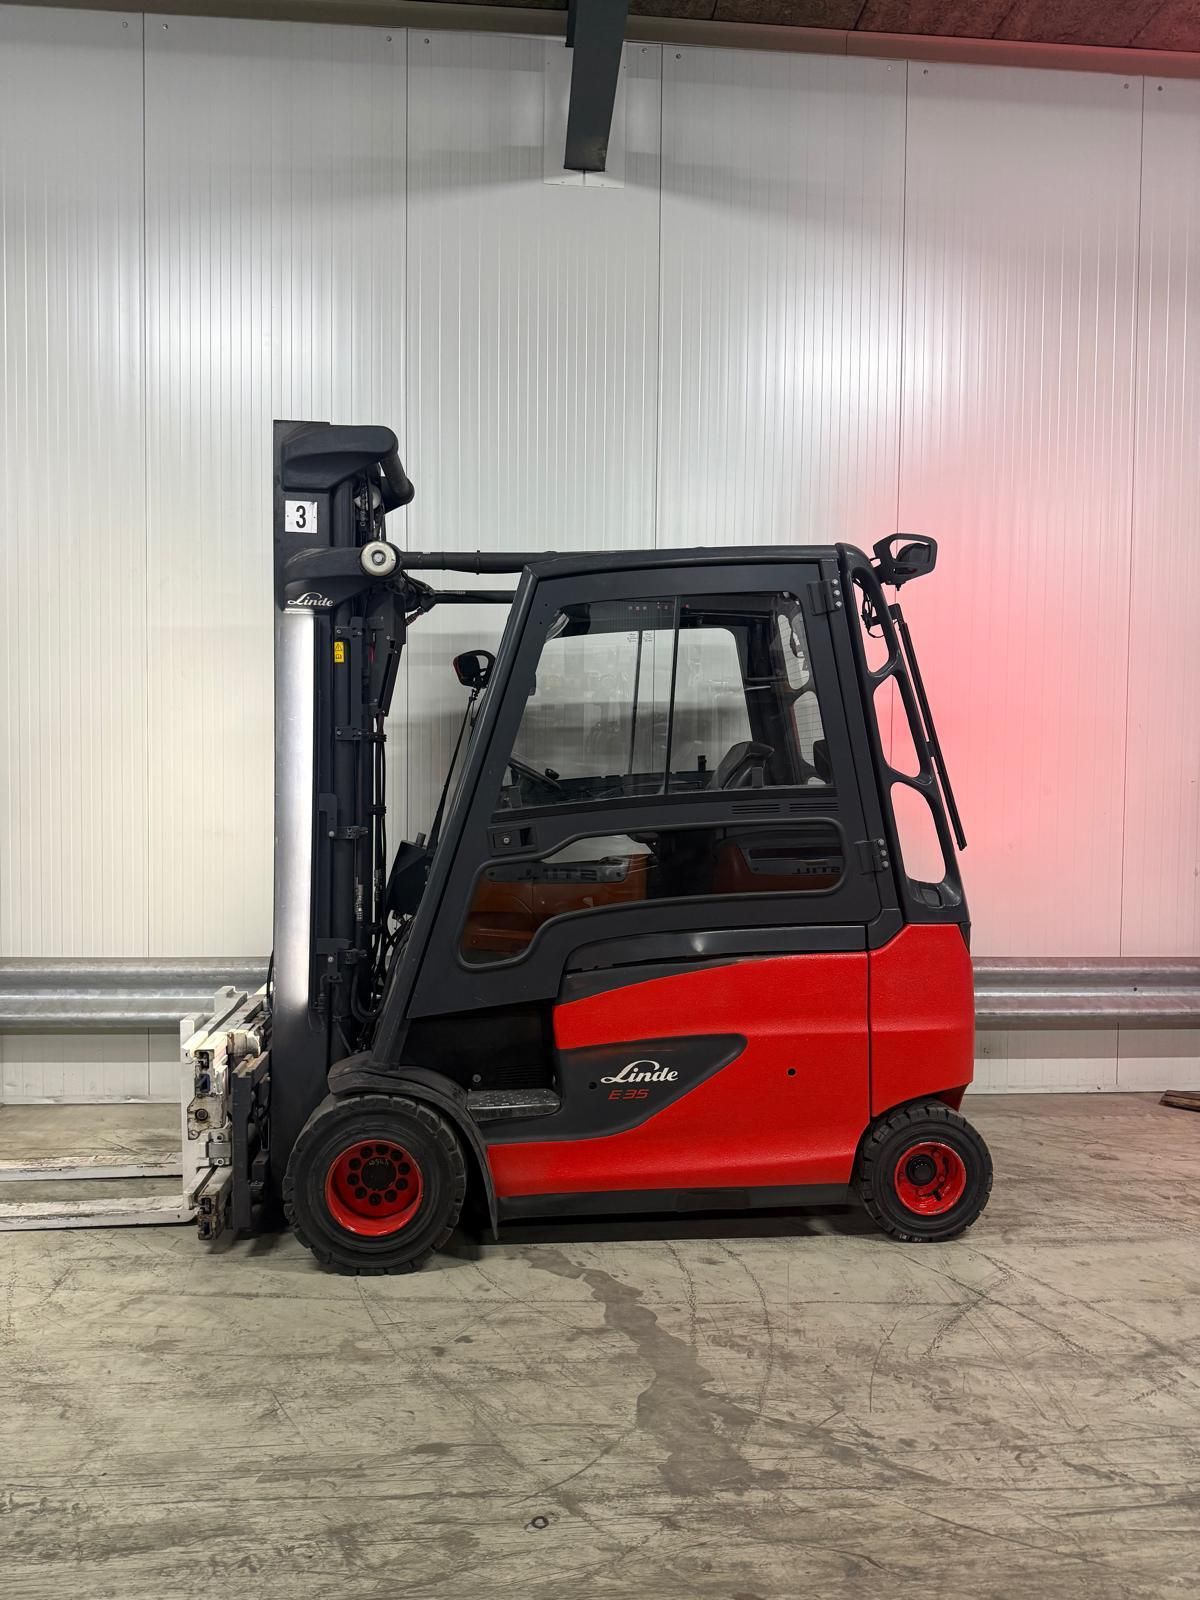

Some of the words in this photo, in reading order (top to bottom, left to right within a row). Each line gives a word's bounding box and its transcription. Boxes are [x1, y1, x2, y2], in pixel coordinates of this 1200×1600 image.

[295, 505, 307, 529] 3
[287, 591, 334, 607] Linde
[600, 1060, 679, 1084] Linde
